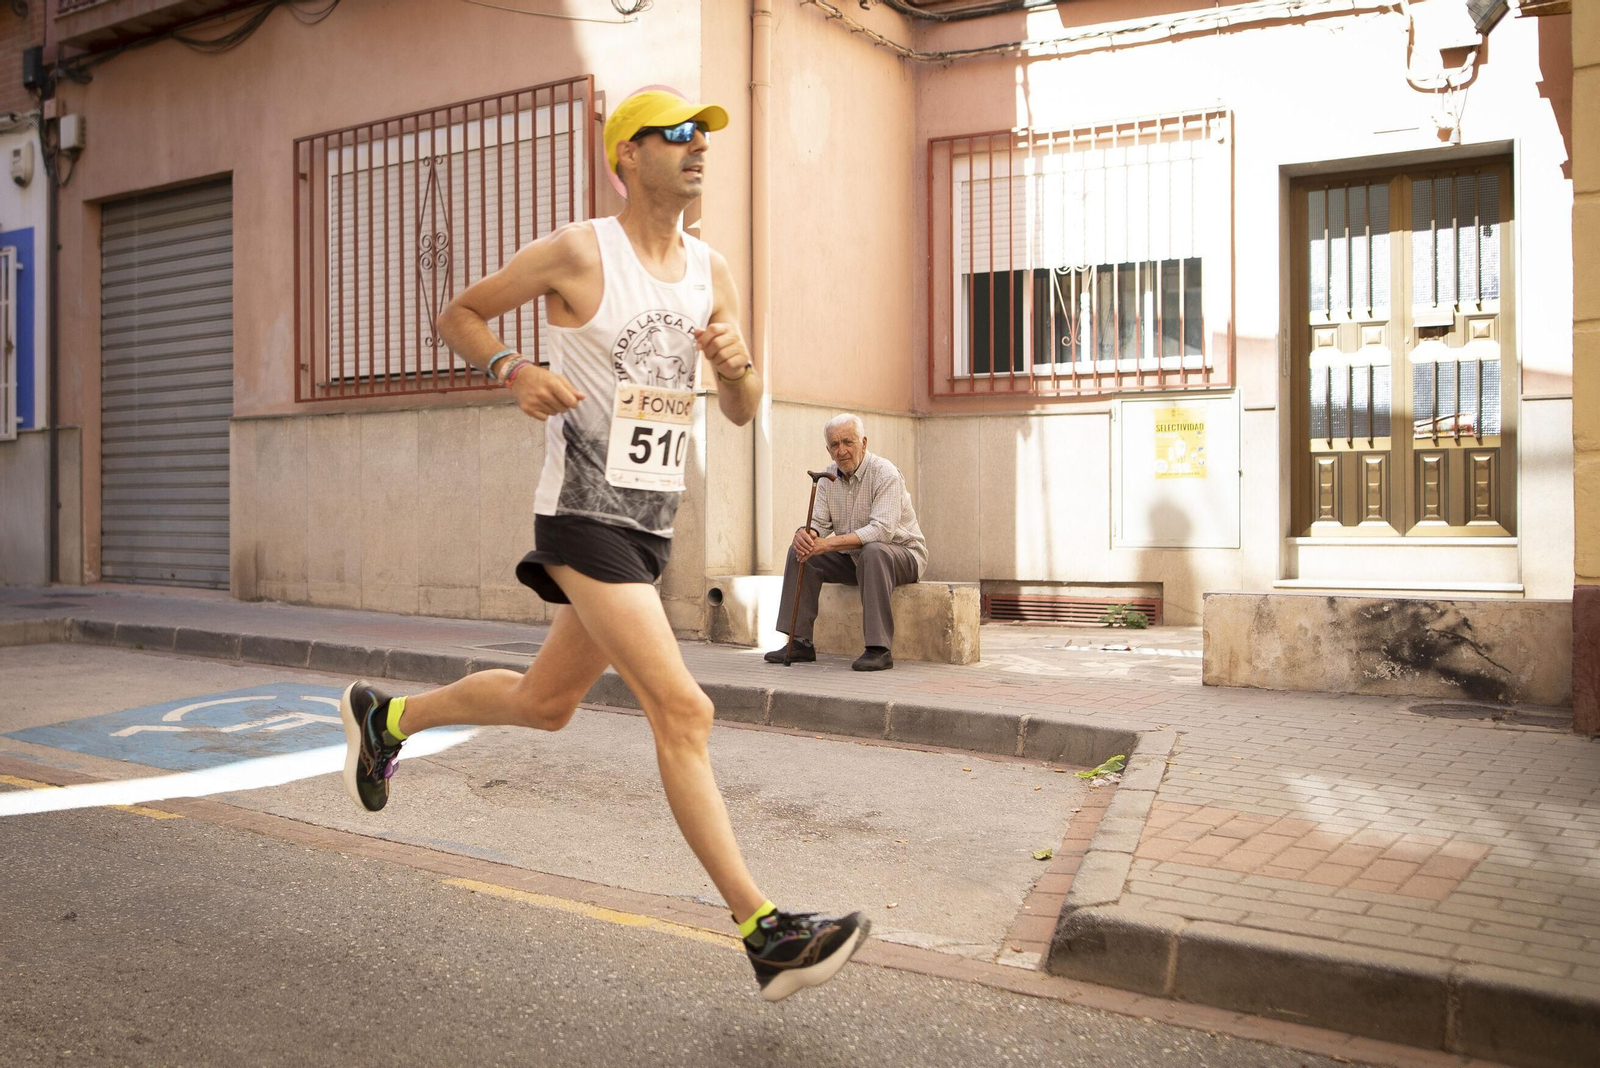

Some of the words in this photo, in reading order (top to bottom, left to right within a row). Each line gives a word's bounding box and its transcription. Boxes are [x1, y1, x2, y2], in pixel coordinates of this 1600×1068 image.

[614, 328, 637, 382] TIRADA
[628, 426, 687, 467] 510
[1155, 423, 1204, 432] SELECTIVIDAD
